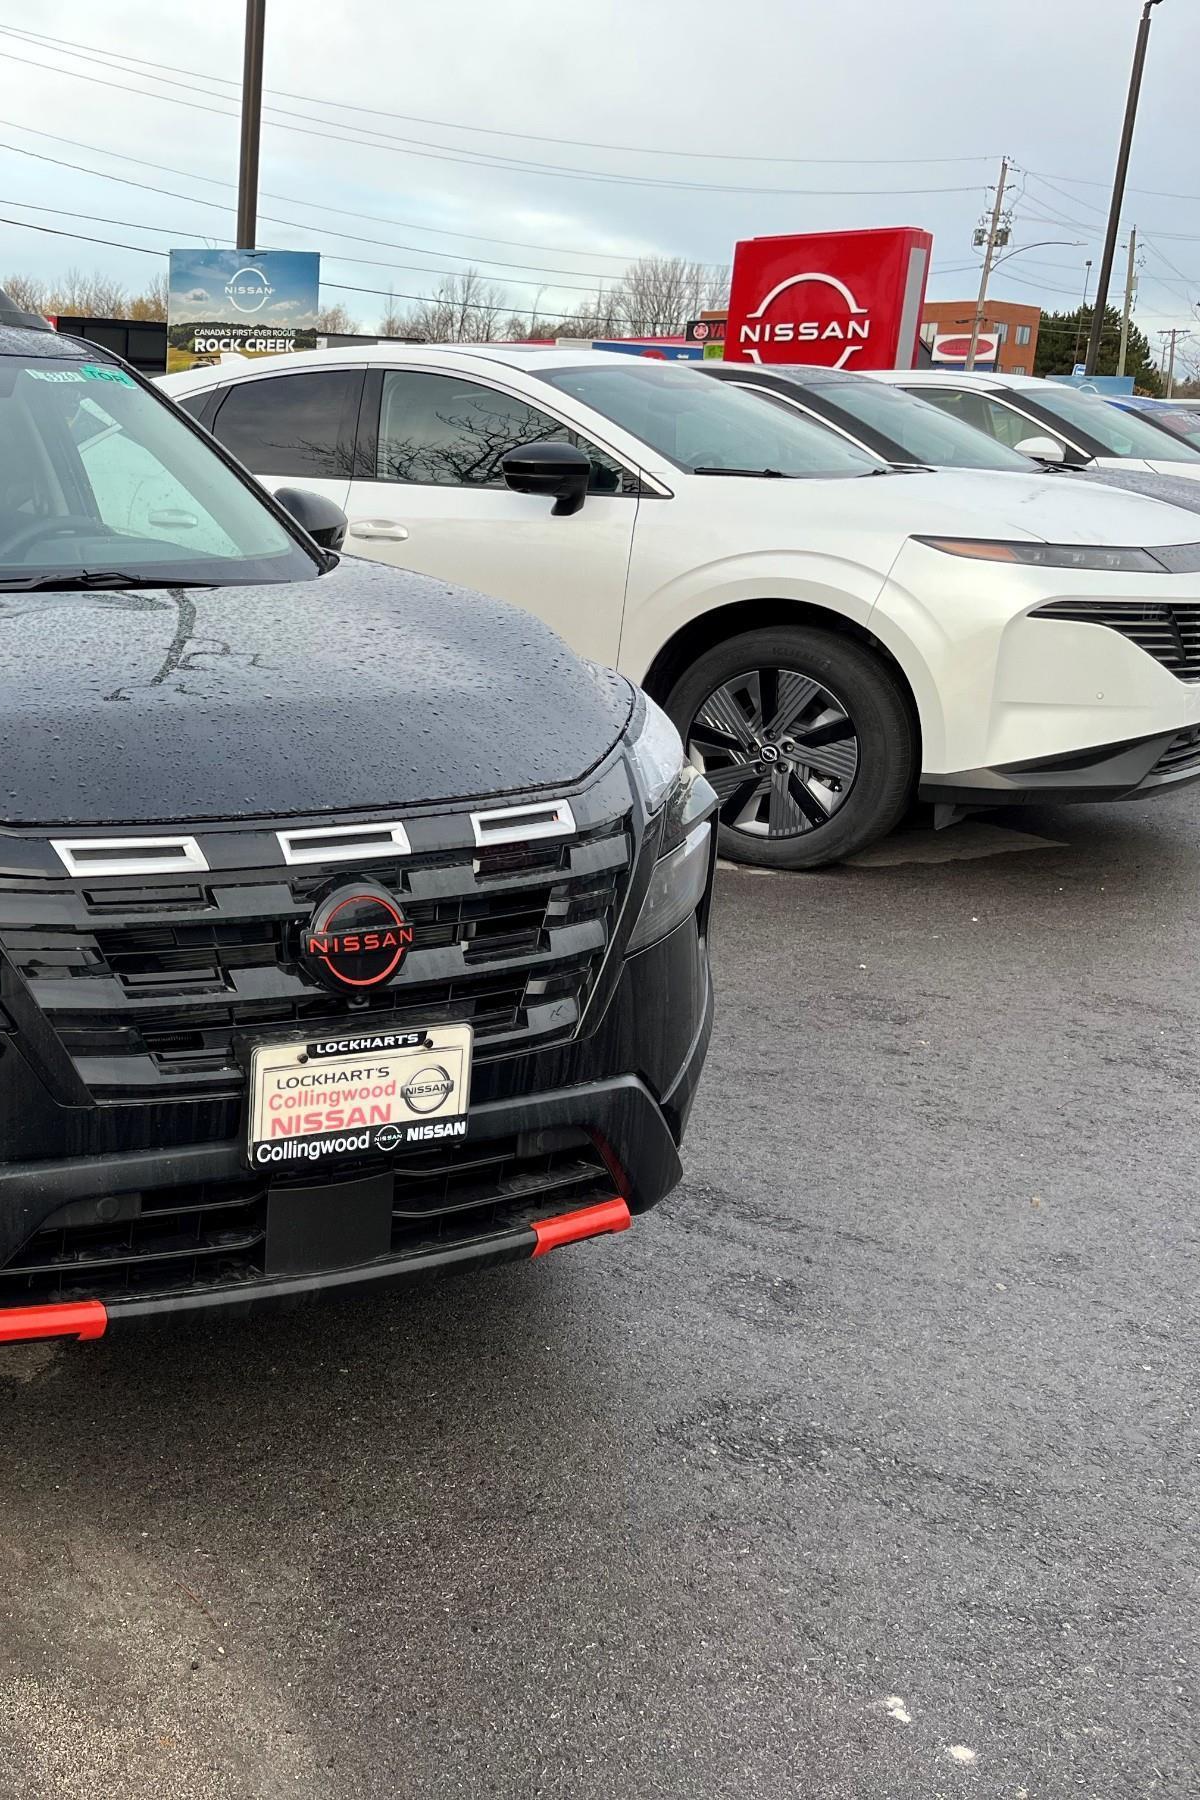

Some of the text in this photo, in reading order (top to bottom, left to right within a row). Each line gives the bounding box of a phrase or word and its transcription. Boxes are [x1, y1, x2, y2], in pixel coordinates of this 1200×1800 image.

[225, 286, 273, 295] NISSAN
[232, 329, 271, 337] FIRST-EVER
[272, 329, 296, 337] ROGUE
[740, 320, 871, 343] NISSAN
[194, 338, 296, 352] ROCK CREEK
[309, 928, 413, 953] NISSAN
[277, 1067, 390, 1090] LOCKHART'S
[406, 1083, 450, 1096] NISSAN
[268, 1080, 397, 1111] Collingwood
[271, 1104, 392, 1137] NISSAN
[257, 1121, 466, 1163] Collingwood NISSAN NISSAN
